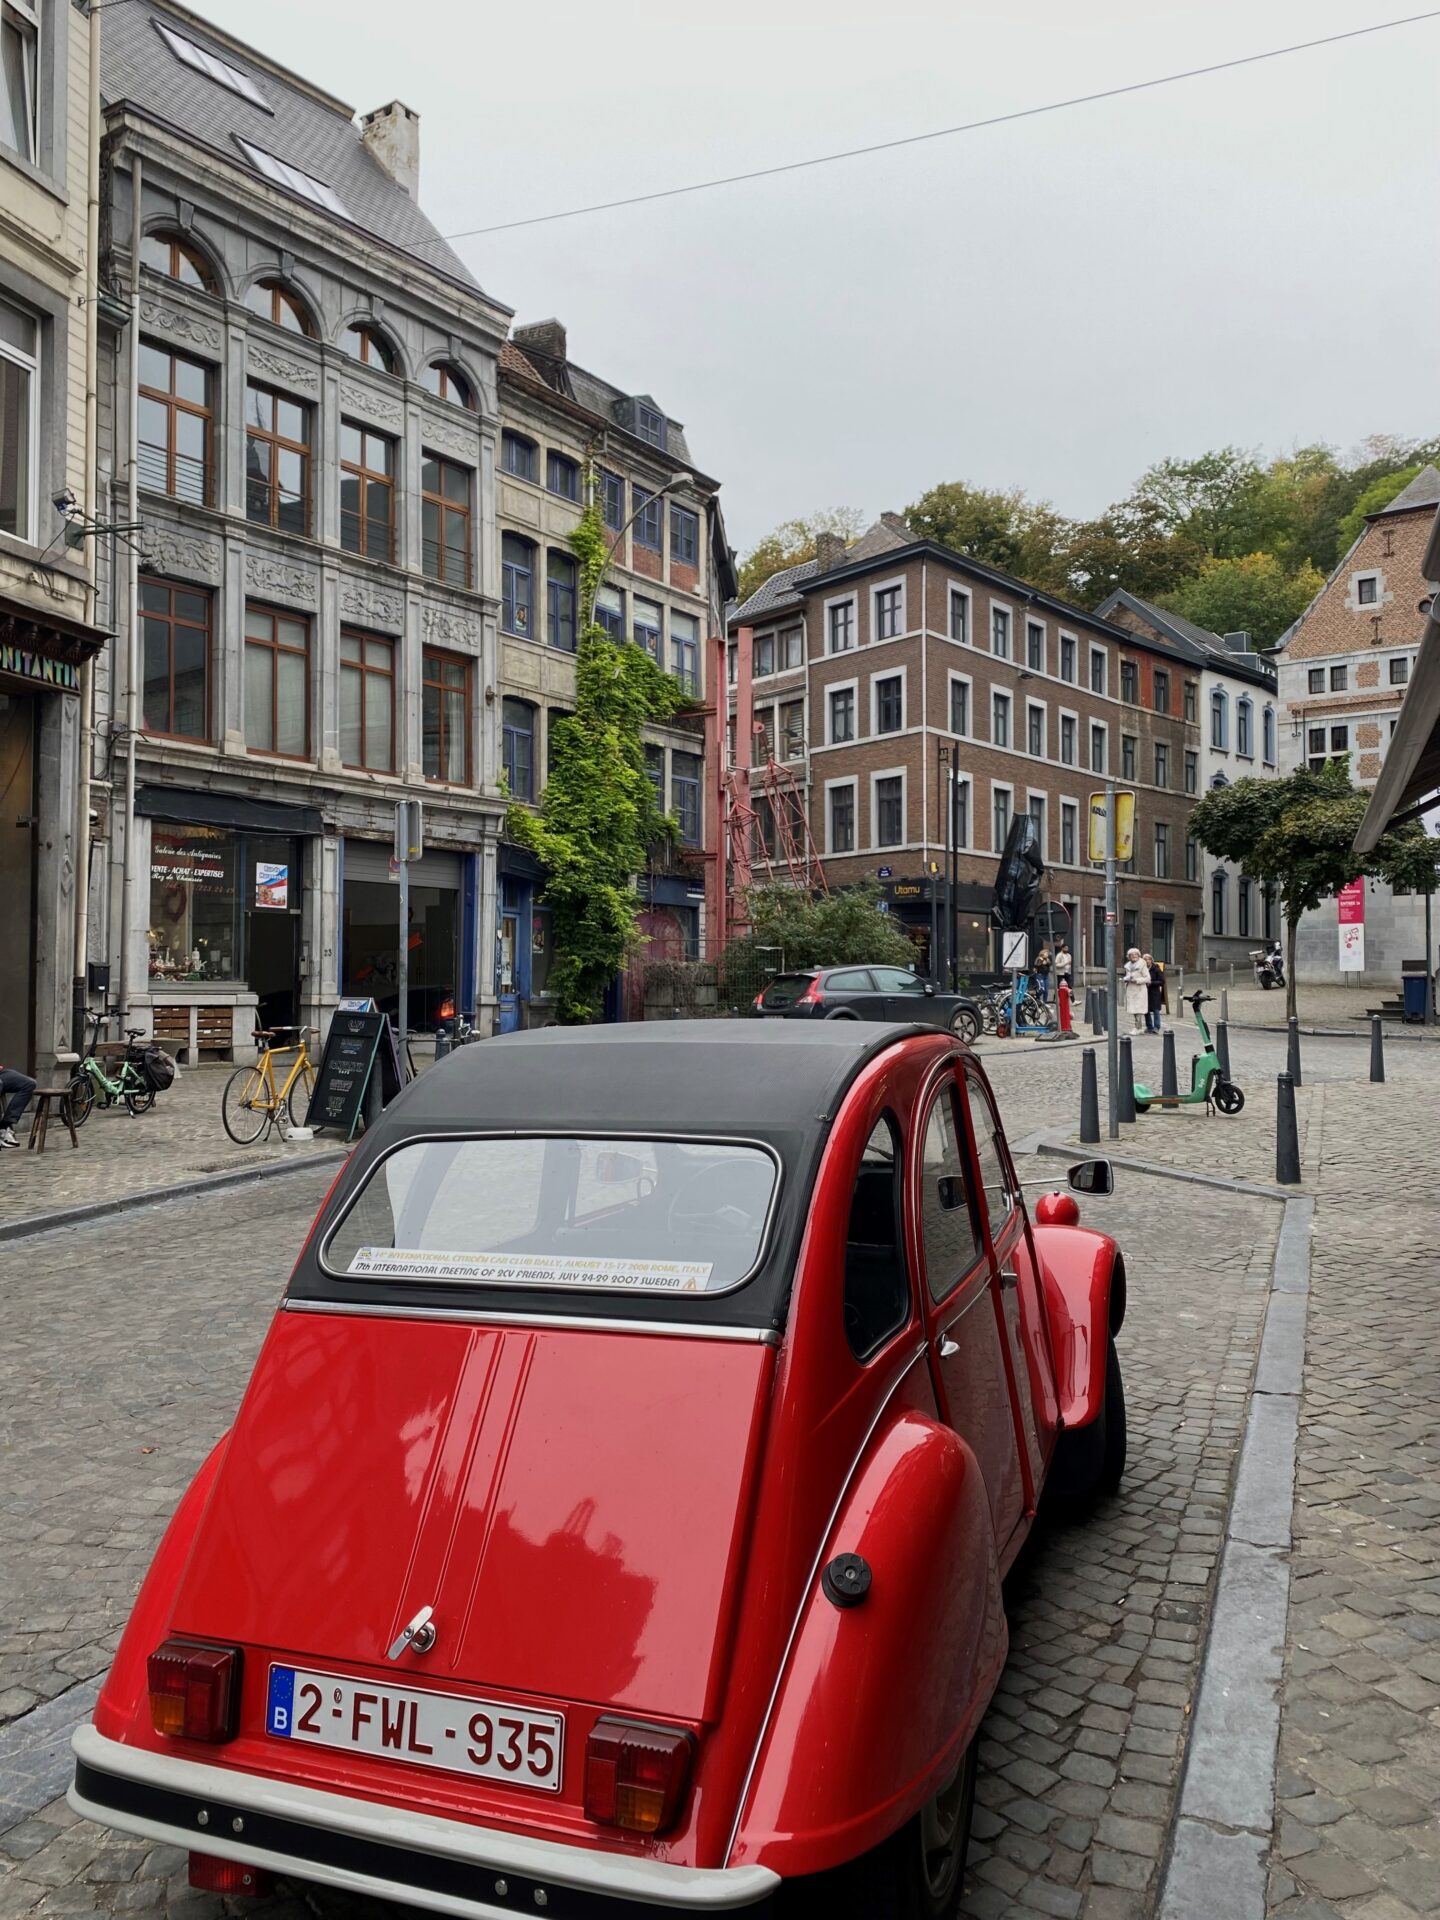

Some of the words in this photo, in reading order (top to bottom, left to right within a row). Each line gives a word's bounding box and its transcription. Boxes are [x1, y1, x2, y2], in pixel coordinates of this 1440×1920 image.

[0, 643, 81, 692] NSTANTIN
[176, 848, 186, 856] des
[151, 865, 168, 874] VENTE
[171, 866, 191, 875] ACHAT
[194, 868, 224, 878] EXPERTISES
[894, 885, 921, 895] Utamu
[388, 1252, 450, 1262] INTERNATIONAL
[509, 1257, 533, 1265] CLUB
[682, 1265, 708, 1274] ITALY
[355, 1262, 371, 1271] 17th
[372, 1263, 438, 1274] INTERNATIONAL
[439, 1266, 480, 1276] MEETING
[481, 1268, 496, 1276] OF
[497, 1269, 515, 1278] 2CV
[516, 1270, 556, 1280] FRIENDS,
[558, 1272, 580, 1281] JULY
[581, 1273, 609, 1283] 24-29
[611, 1275, 639, 1284] 2007
[640, 1276, 680, 1287] SWEDEN
[273, 1706, 288, 1730] B
